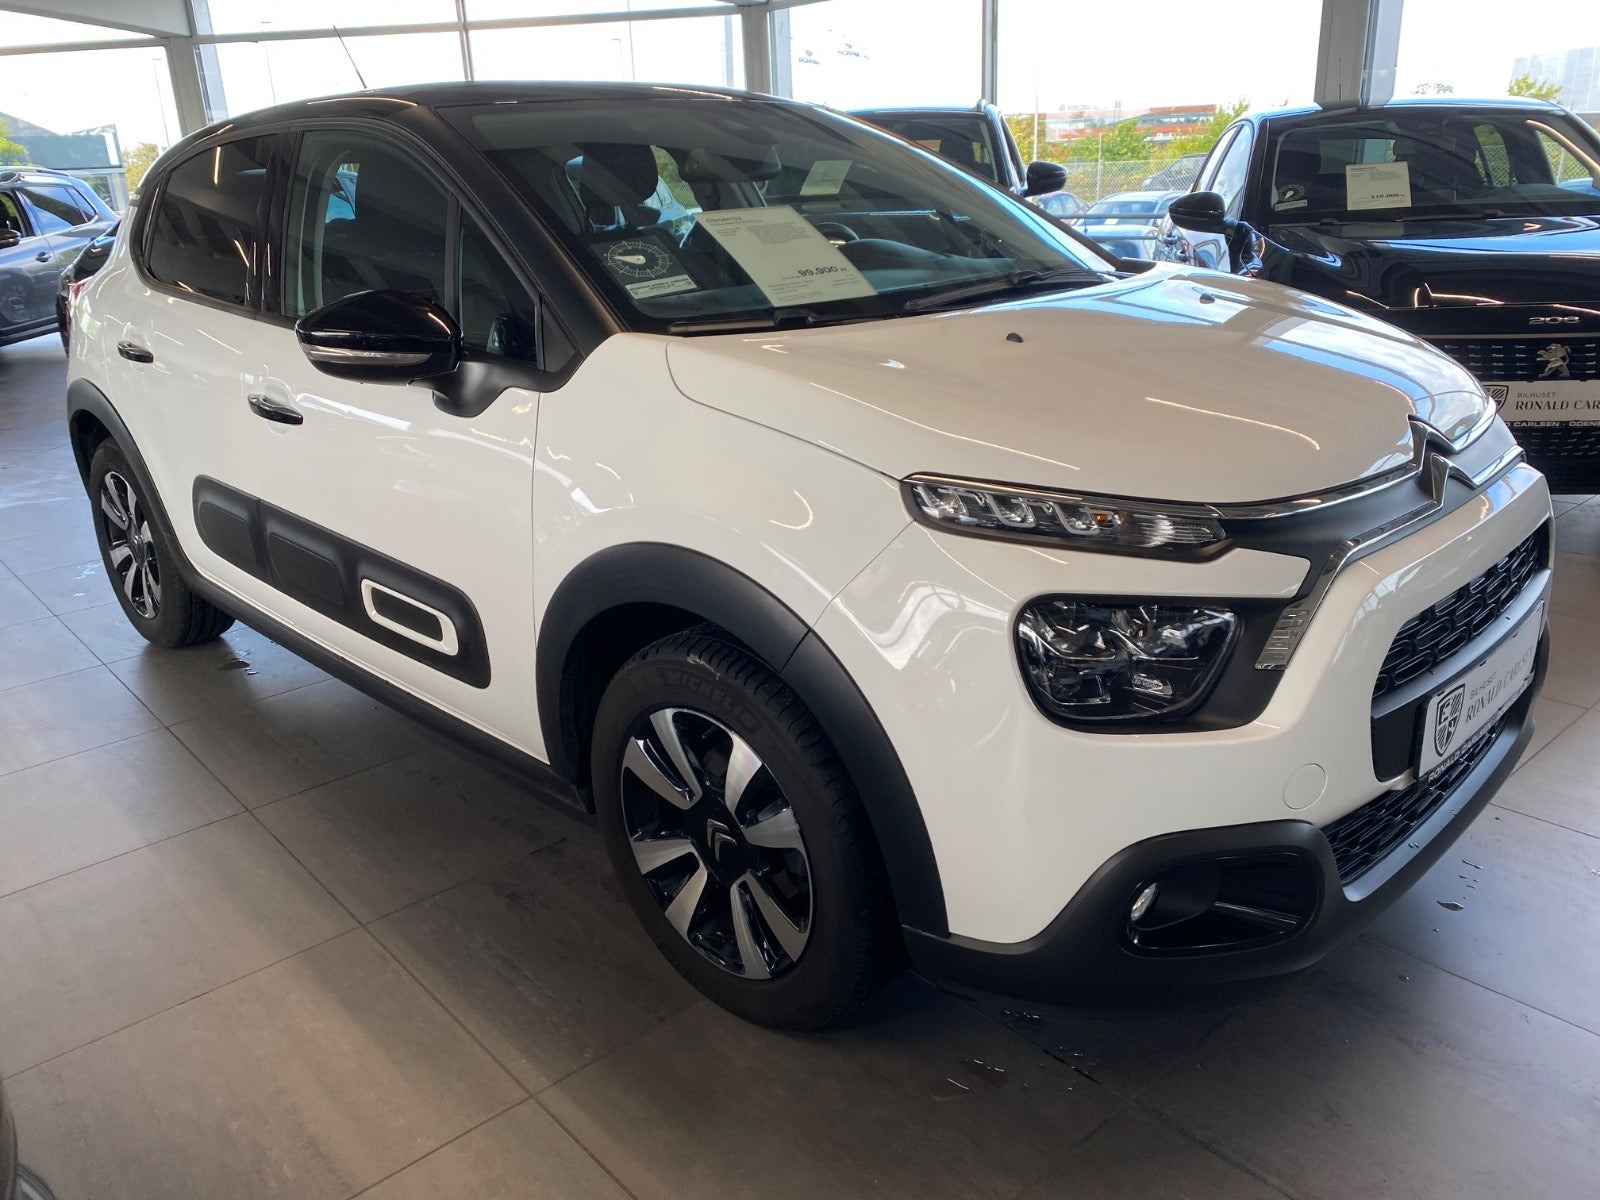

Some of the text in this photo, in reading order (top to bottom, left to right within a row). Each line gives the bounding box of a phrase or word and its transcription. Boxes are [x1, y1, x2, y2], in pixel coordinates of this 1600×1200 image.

[798, 265, 839, 277] 99.900
[1528, 316, 1581, 325] 208
[1515, 400, 1569, 410] RONALD
